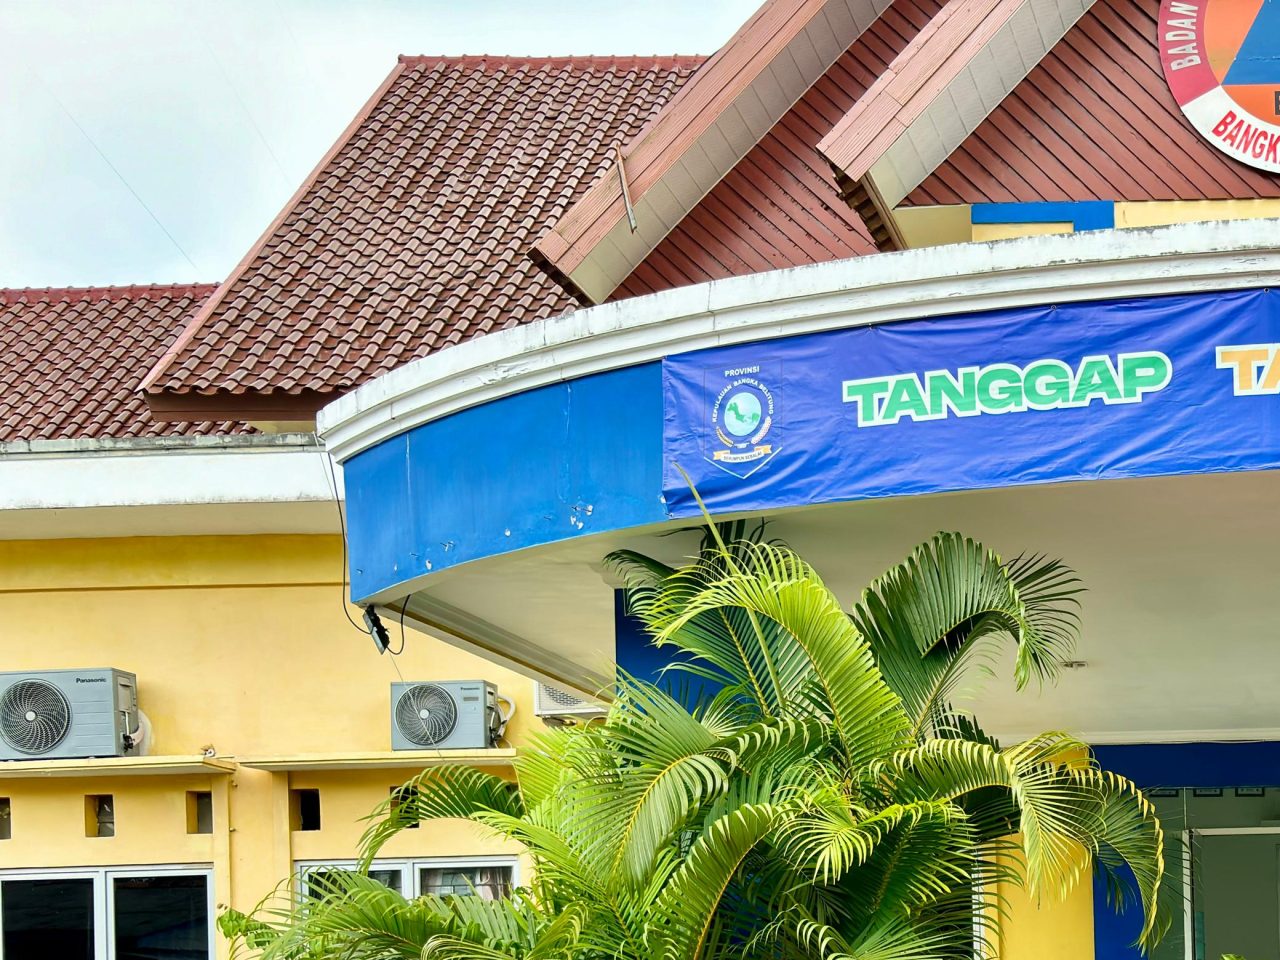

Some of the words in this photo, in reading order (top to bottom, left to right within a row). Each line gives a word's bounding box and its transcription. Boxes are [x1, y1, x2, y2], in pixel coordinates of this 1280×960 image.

[1165, 1, 1201, 71] BADAN
[712, 384, 733, 423] KEPULAUAN
[733, 377, 758, 387] BANGKA
[758, 383, 774, 415] BELITUNG
[724, 365, 760, 377] PROVINSI
[842, 350, 1173, 427] TANGGAP
